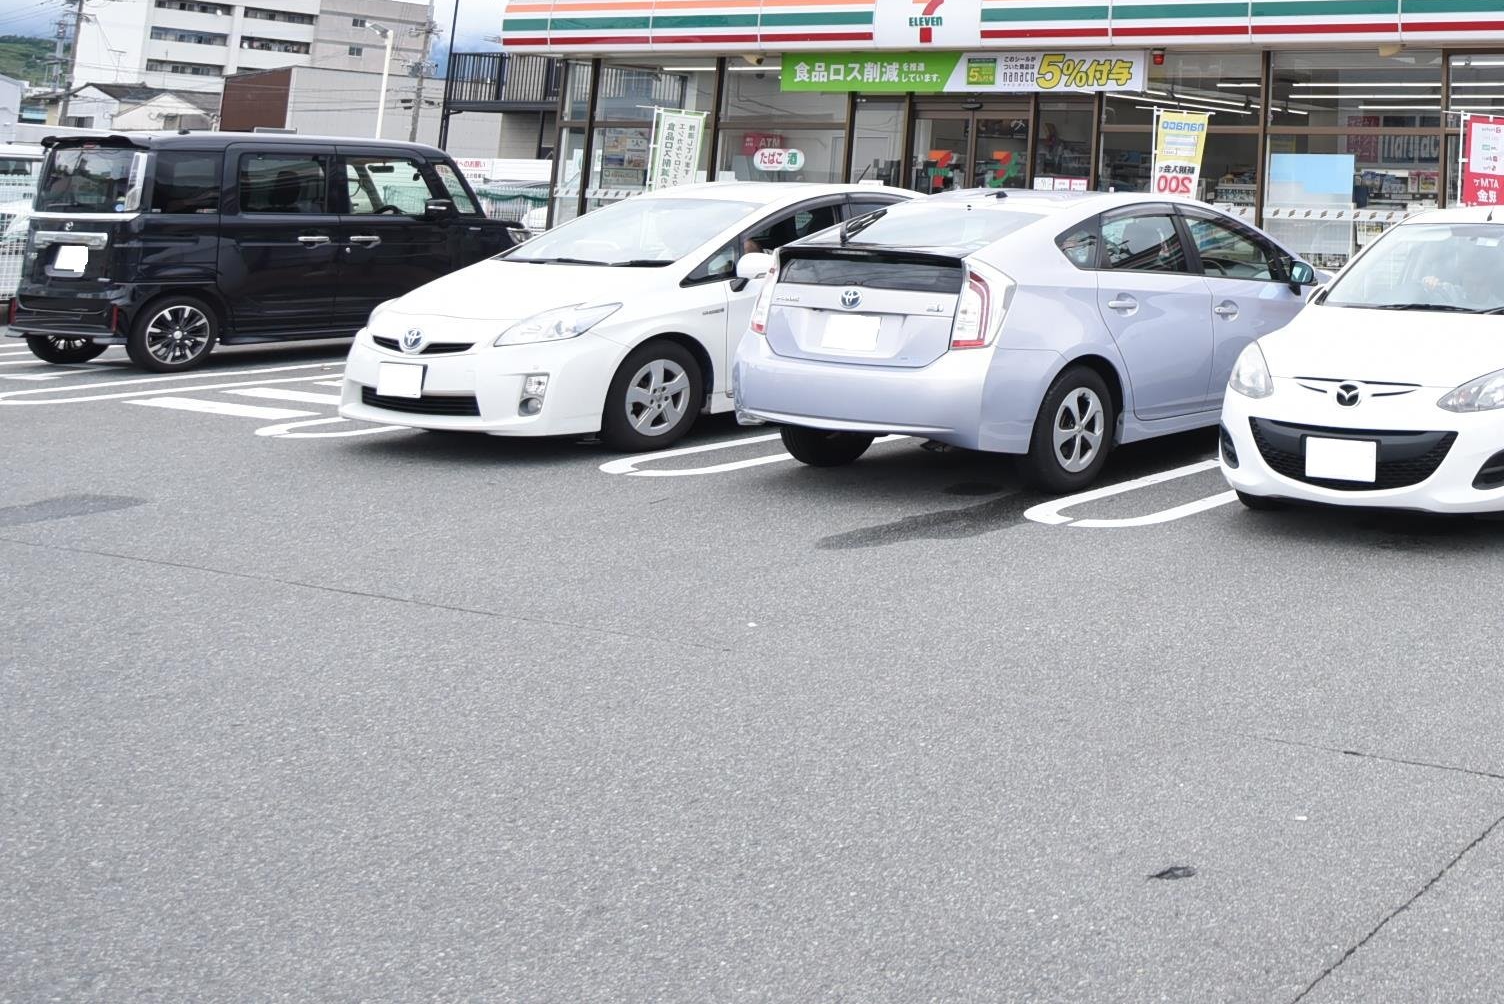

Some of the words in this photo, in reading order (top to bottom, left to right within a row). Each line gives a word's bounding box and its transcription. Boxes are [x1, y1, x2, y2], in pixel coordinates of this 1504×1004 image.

[1003, 55, 1037, 63] このシールが
[794, 61, 900, 83] 食品ロス削減
[1003, 63, 1036, 71] ついた商品は
[1036, 53, 1134, 89] 5%付与
[1003, 71, 1036, 83] nanaco
[759, 151, 783, 165] たばこ
[787, 152, 798, 165] 酒
